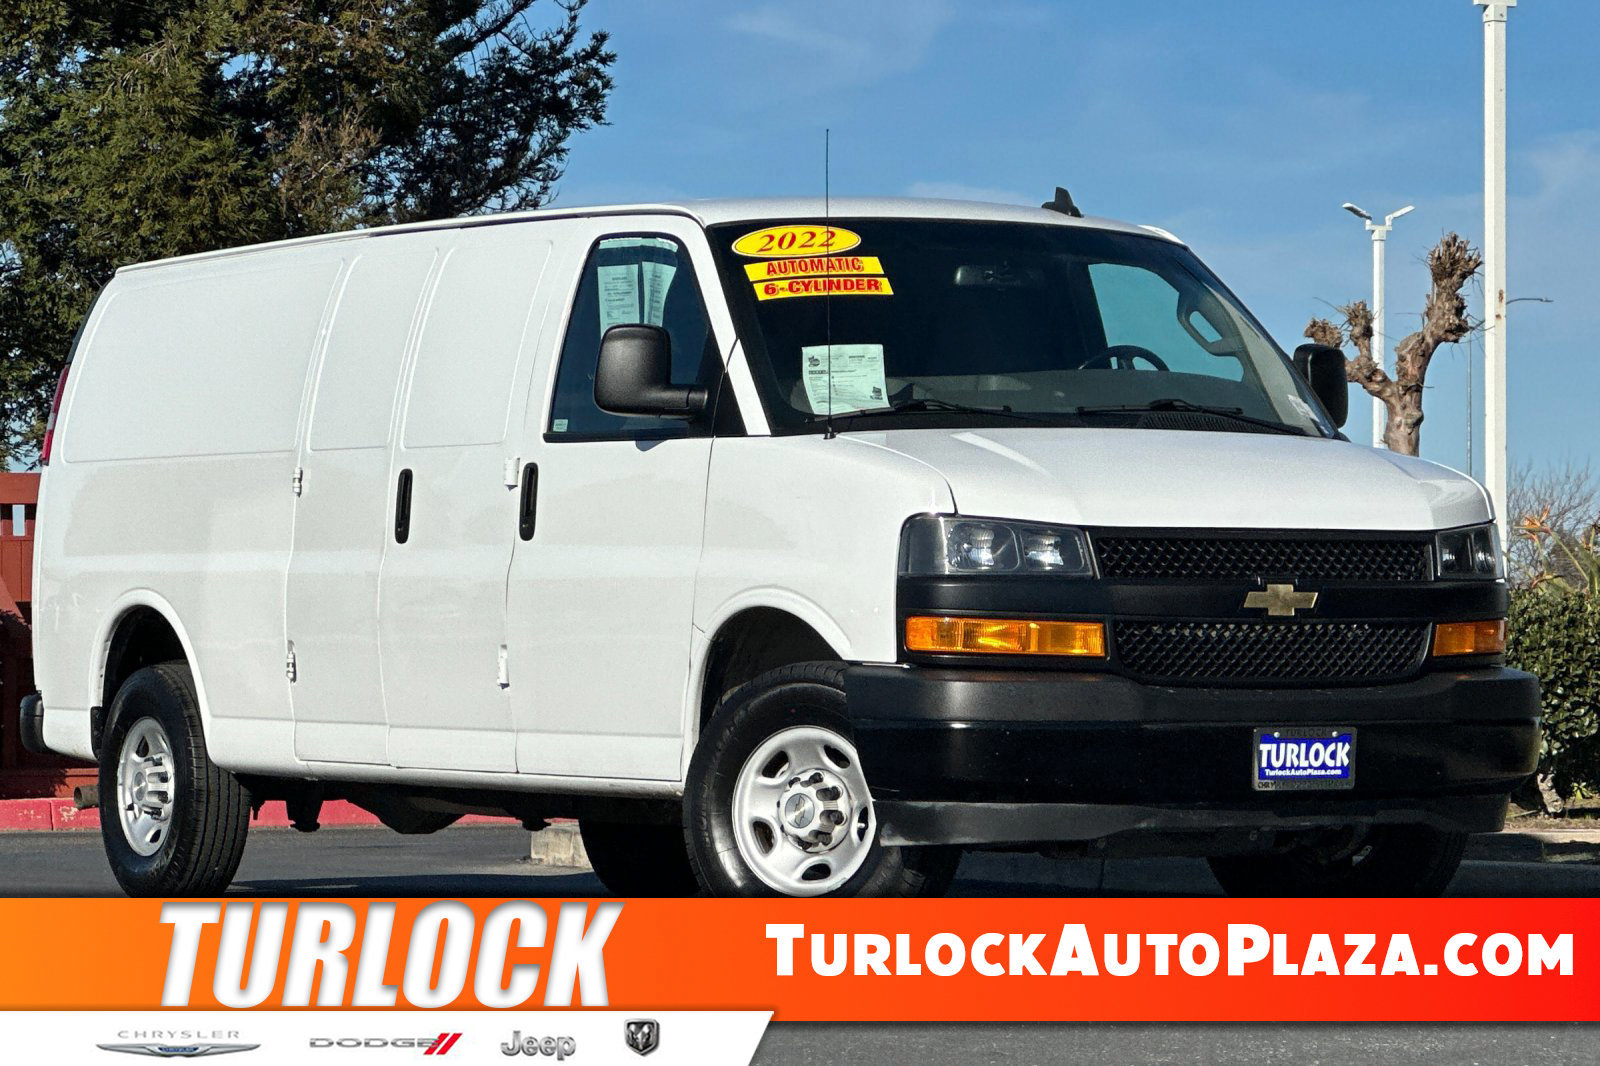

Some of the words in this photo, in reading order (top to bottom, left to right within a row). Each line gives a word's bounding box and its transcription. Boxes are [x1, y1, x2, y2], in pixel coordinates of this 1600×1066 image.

[756, 230, 836, 253] 2022
[766, 257, 864, 276] AUTOMATIC
[764, 279, 882, 296] 6-CYLINDER
[1259, 742, 1351, 768] TURLOCK
[1265, 768, 1342, 776] TurlockAutoPlaza.com
